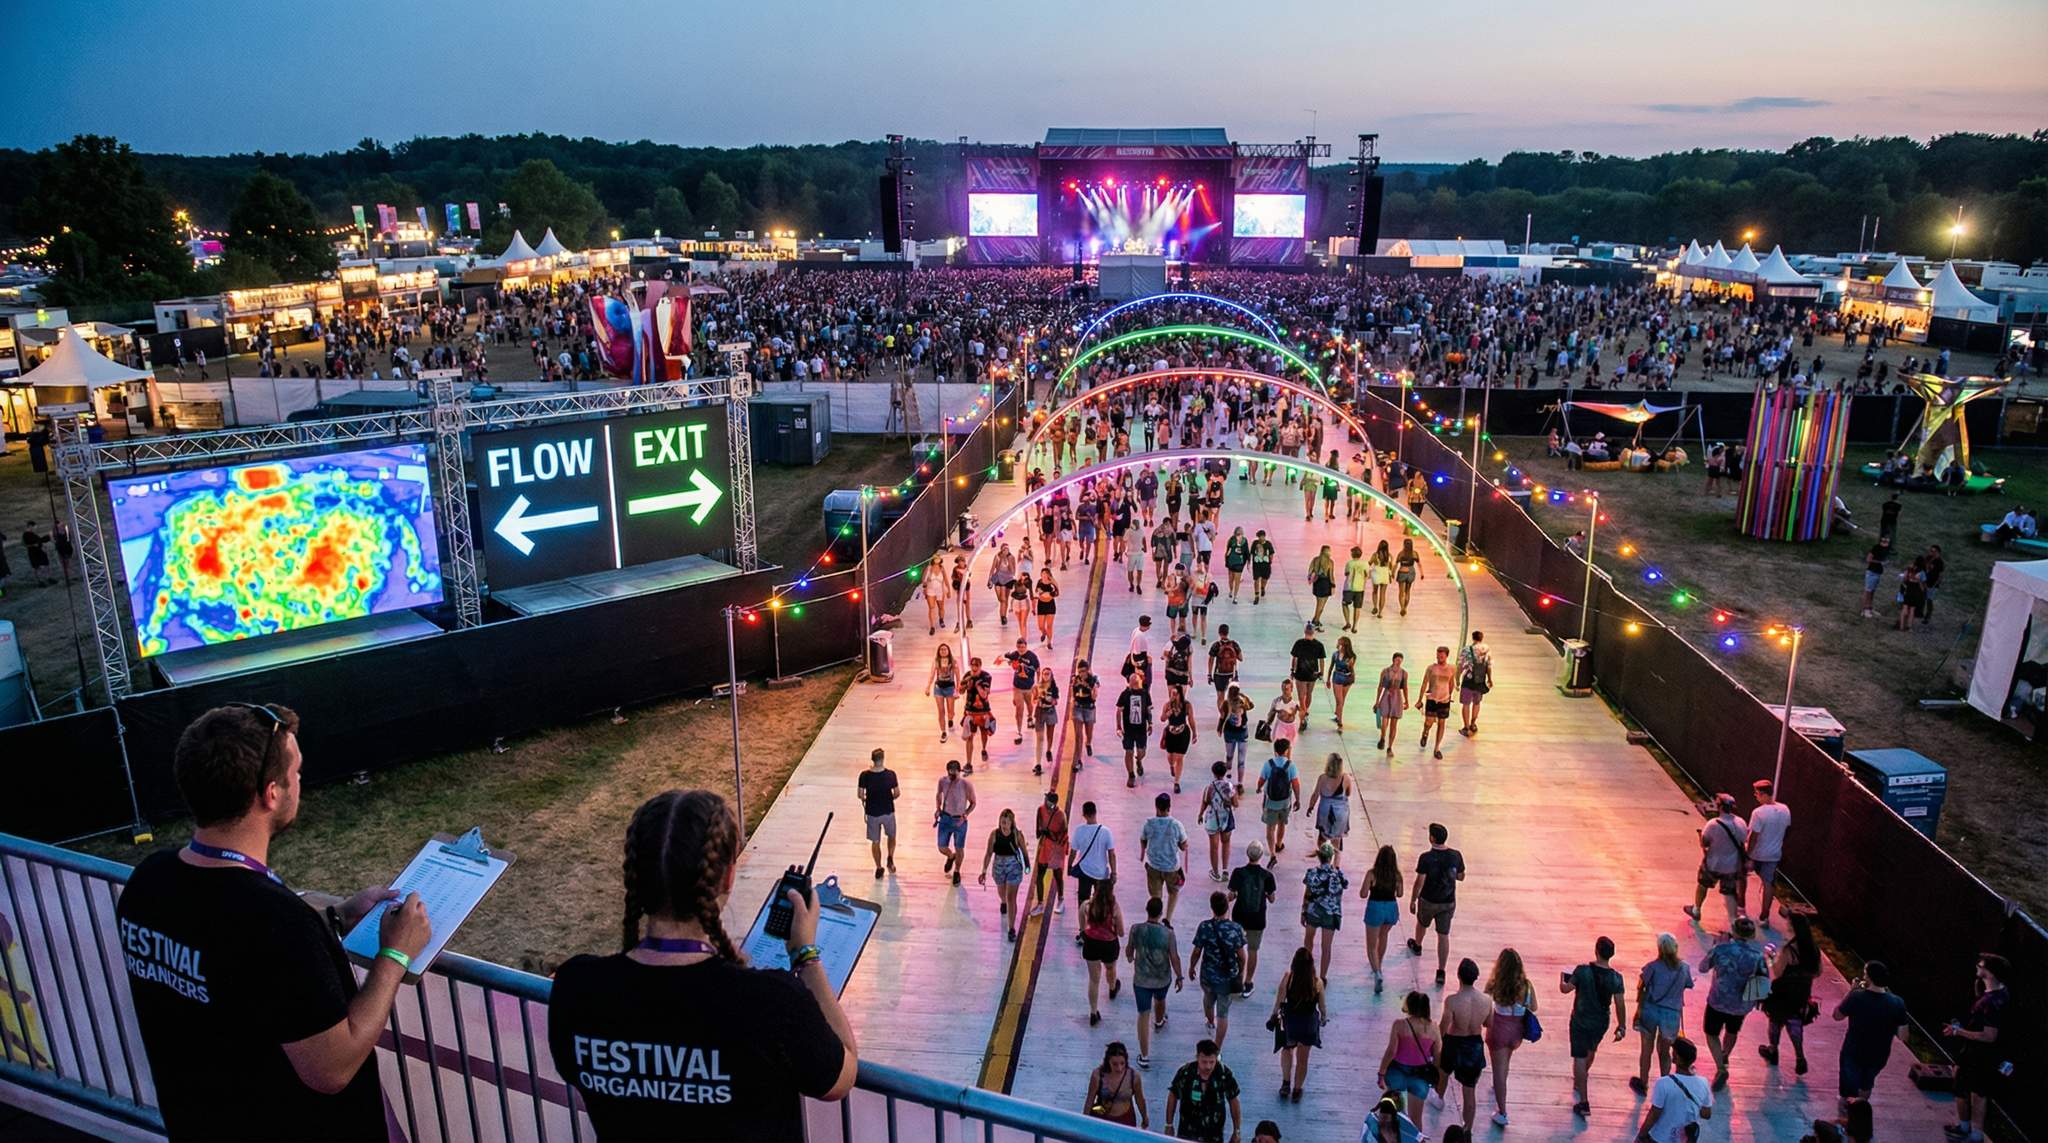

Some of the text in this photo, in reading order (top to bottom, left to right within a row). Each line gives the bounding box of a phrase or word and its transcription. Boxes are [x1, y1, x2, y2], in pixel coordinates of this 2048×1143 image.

[487, 437, 593, 487] FLOW
[633, 423, 708, 467] EXIT
[120, 917, 206, 982] FESTIVAL
[574, 1035, 731, 1081] FESTIVAL
[579, 1071, 732, 1104] ORGANIZERS
